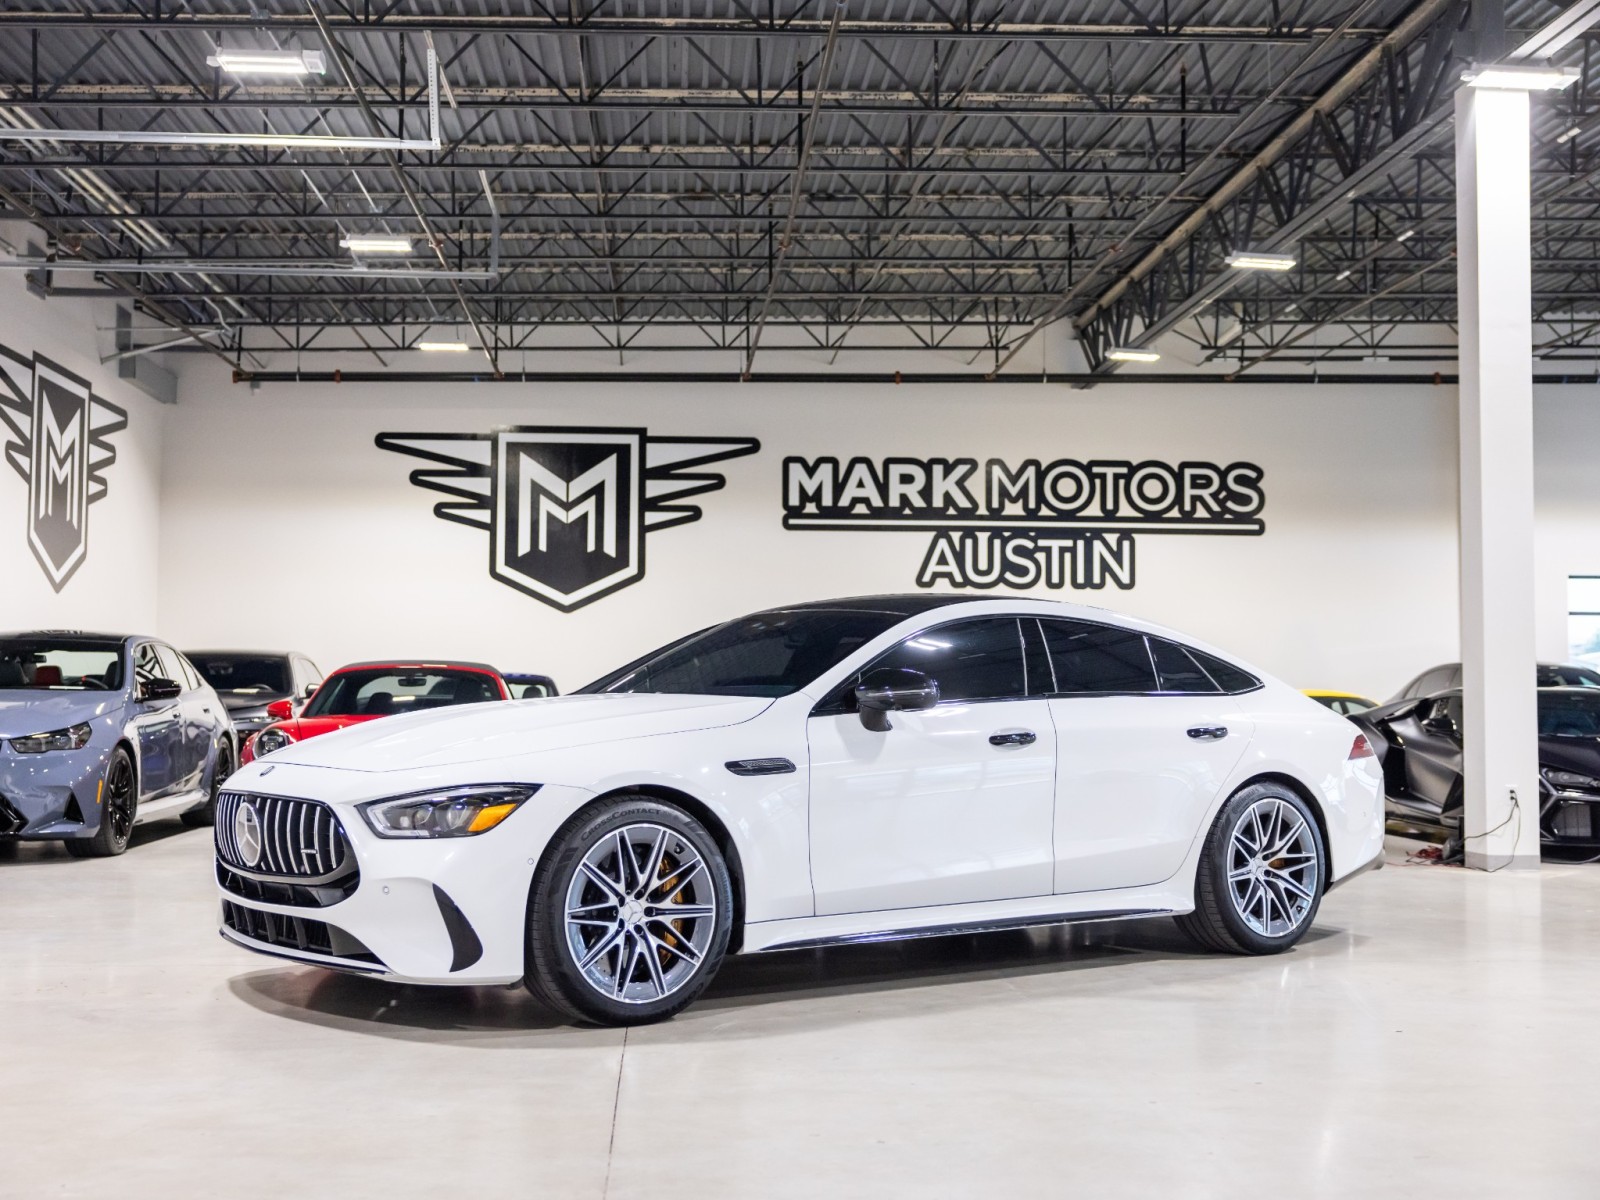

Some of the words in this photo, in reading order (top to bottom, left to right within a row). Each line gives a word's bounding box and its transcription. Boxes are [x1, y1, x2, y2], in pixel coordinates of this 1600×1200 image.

[786, 461, 974, 510] MARK
[990, 463, 1261, 514] MOTORS
[920, 535, 1131, 585] AUSTIN
